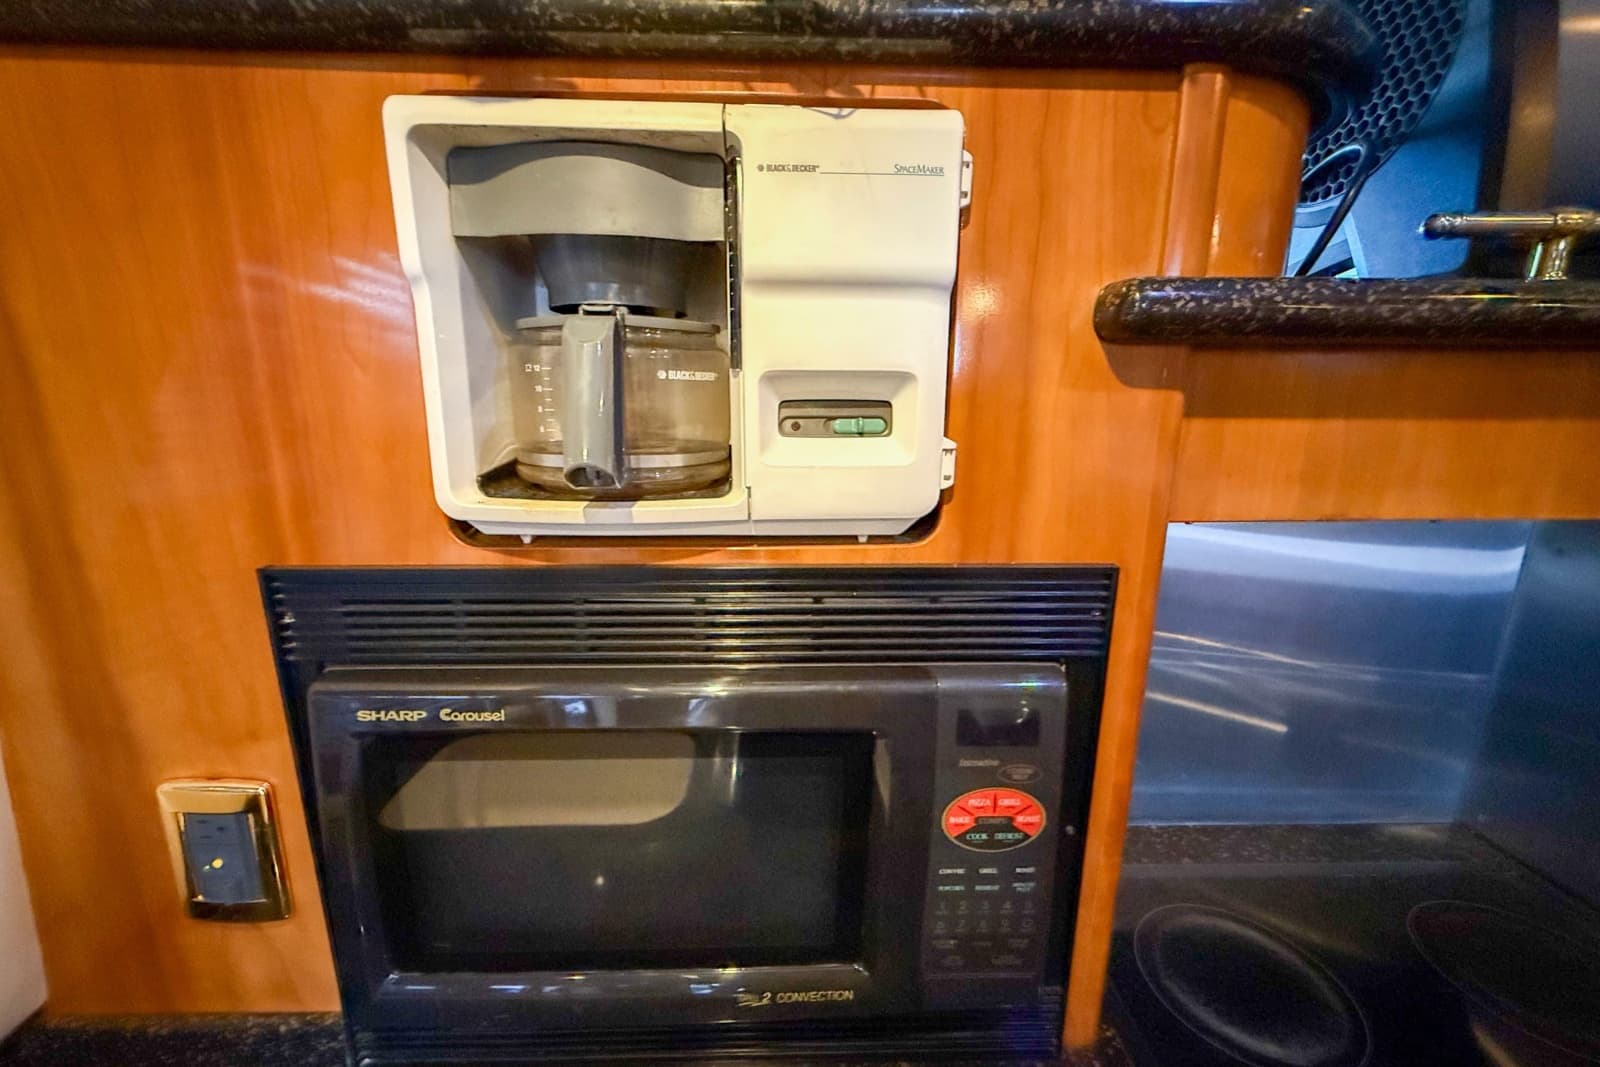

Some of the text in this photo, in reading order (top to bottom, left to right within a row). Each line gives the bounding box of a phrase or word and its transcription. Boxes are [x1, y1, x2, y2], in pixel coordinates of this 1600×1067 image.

[356, 708, 505, 721] SHARP Carousel
[776, 990, 853, 1002] CONVECTION
